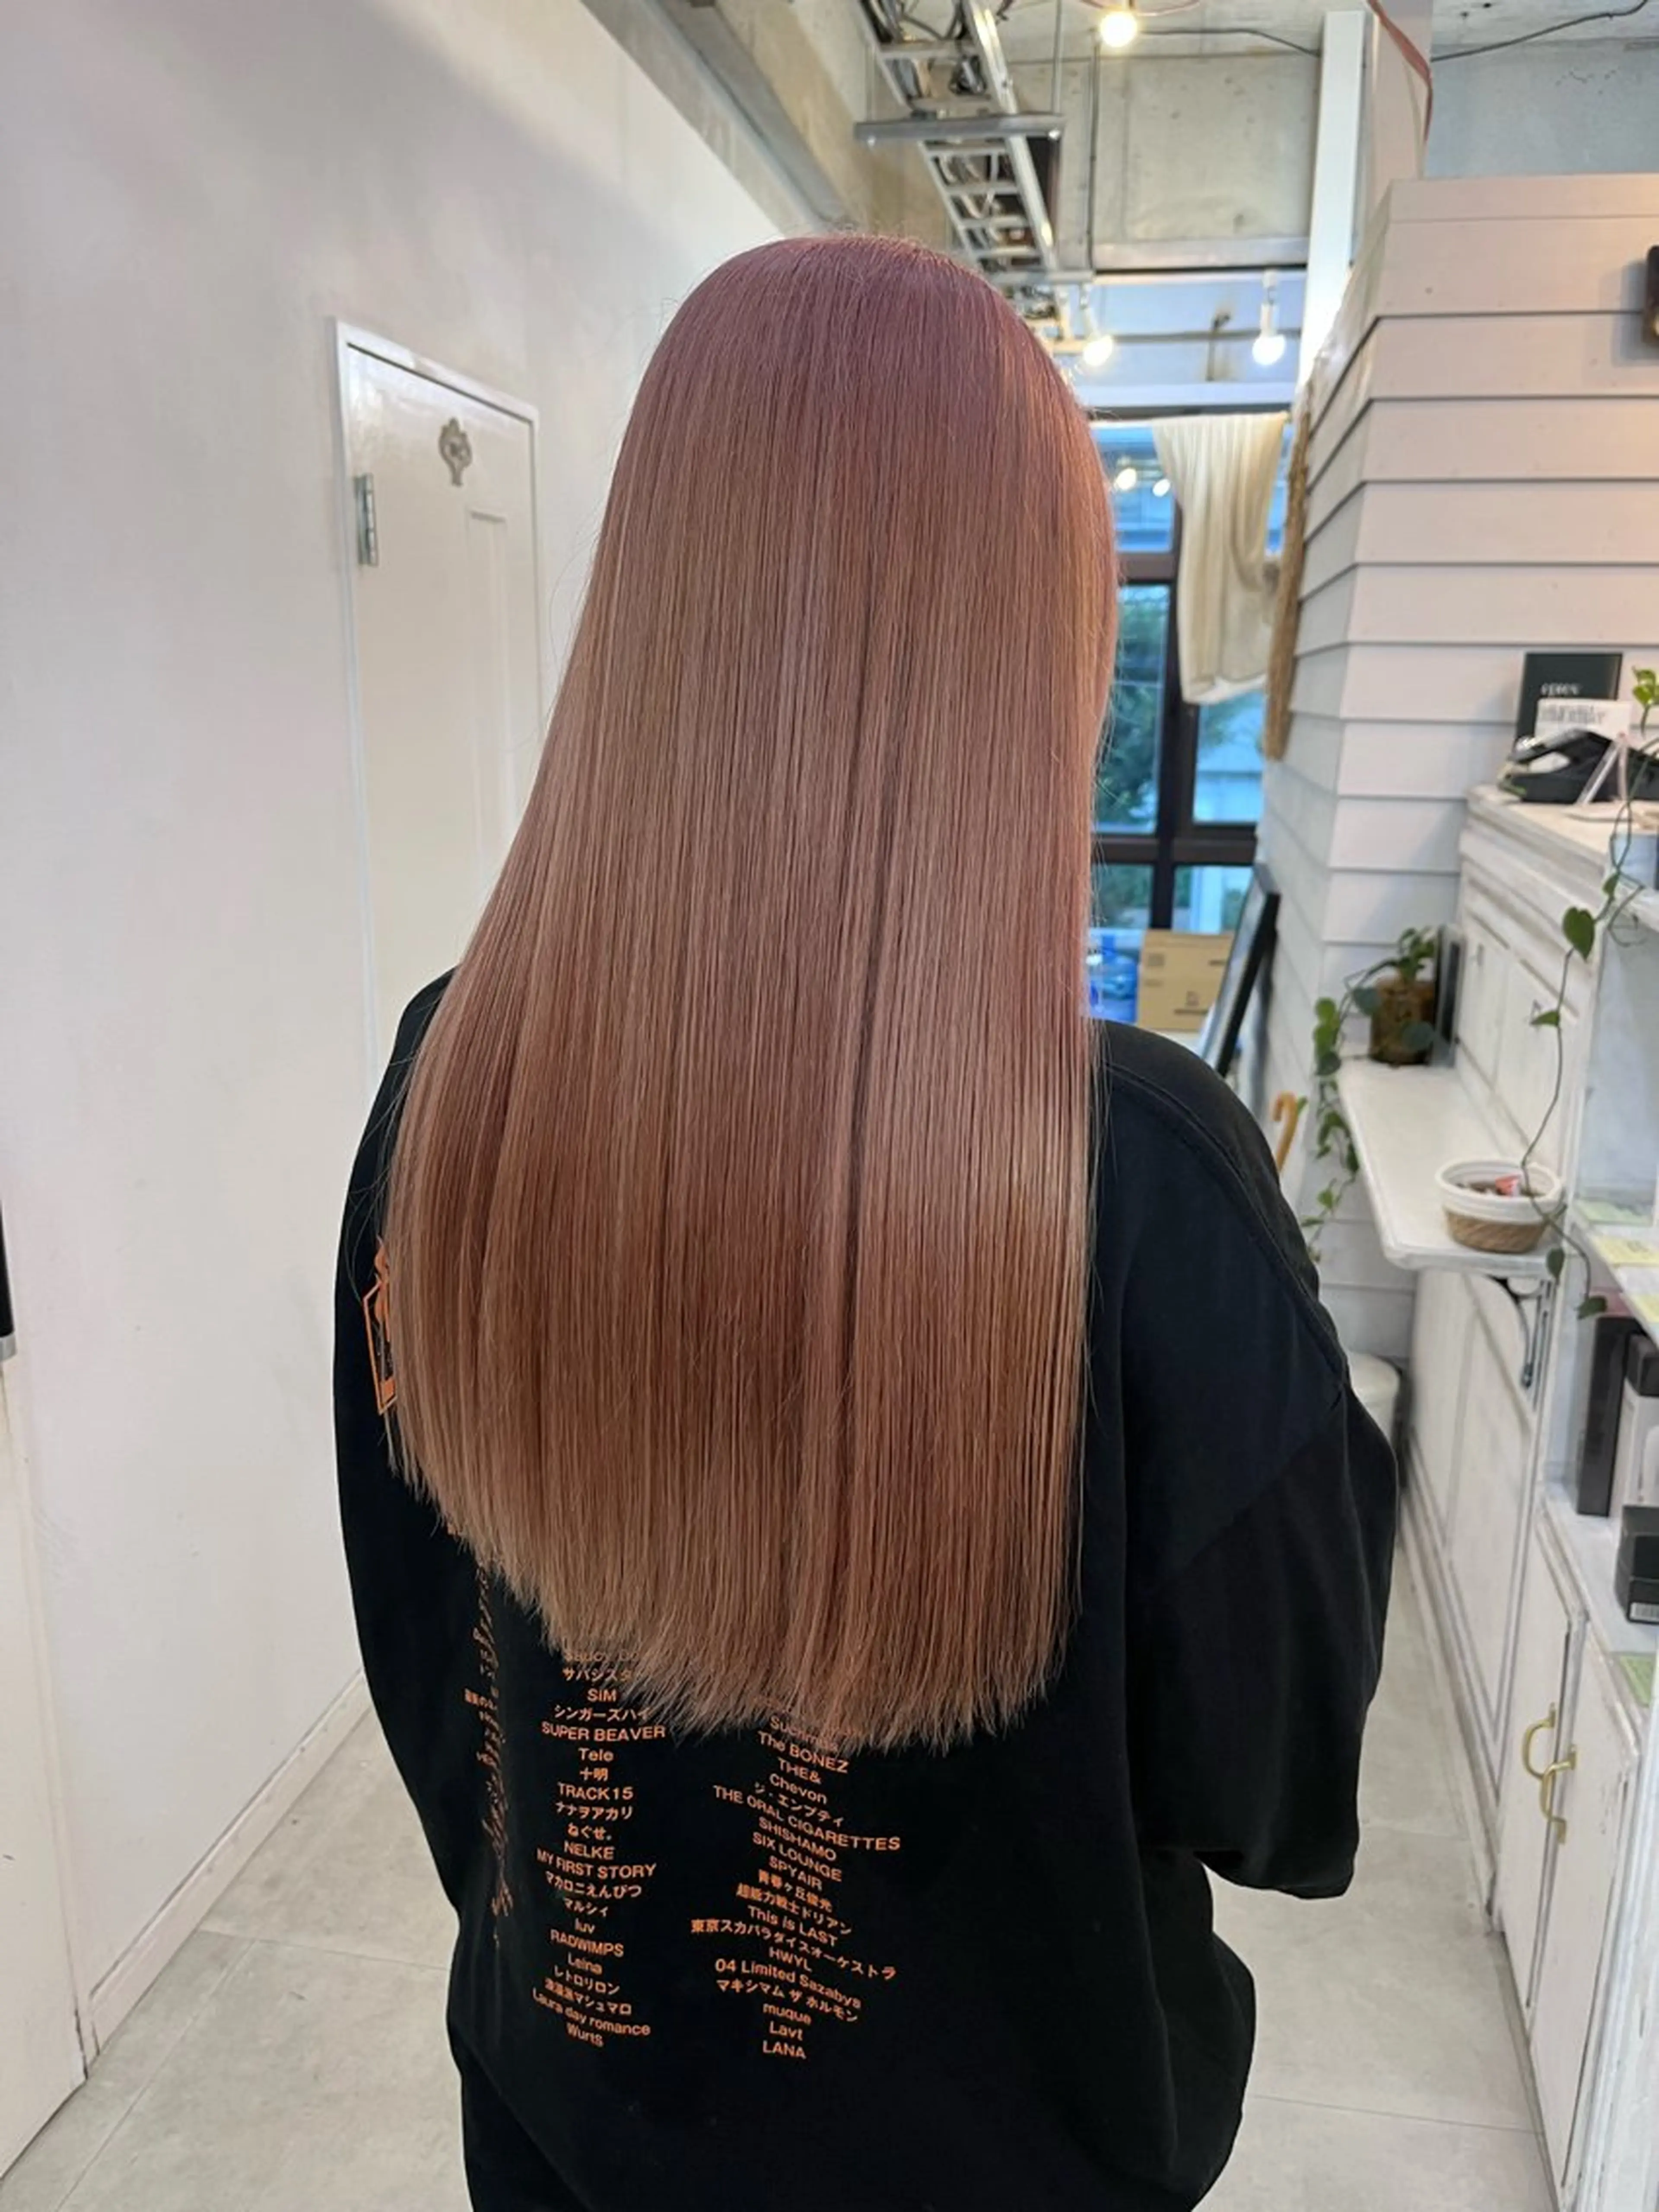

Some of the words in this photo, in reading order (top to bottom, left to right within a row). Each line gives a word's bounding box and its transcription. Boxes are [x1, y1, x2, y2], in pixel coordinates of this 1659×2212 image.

[587, 1688, 617, 1702] SIM
[555, 1704, 649, 1722] シンガーズハイ
[541, 1721, 590, 1740] SUPER
[594, 1725, 666, 1742] BEAVER
[578, 1748, 614, 1762] Tele
[758, 1731, 785, 1751] The
[789, 1744, 849, 1773] BONEZ
[580, 1767, 608, 1781] 十明
[778, 1757, 821, 1784] THE&
[769, 1773, 827, 1805] Chevon
[556, 1801, 633, 1821] ナナヲアカリ
[713, 1785, 744, 1804] THE
[747, 1795, 784, 1821] ORAL
[788, 1815, 901, 1851] CIGARETTES
[564, 1840, 615, 1860] NELKE
[758, 1816, 837, 1861] SHISHAMO
[537, 1847, 554, 1865] MY
[556, 1856, 594, 1877] FIRST
[597, 1862, 657, 1879] STORY
[753, 1831, 776, 1851] SIX
[779, 1844, 842, 1882] LOUNGE
[545, 1870, 642, 1899] マカロニえんぴつ
[769, 1855, 823, 1891] SPYAIR
[575, 1917, 595, 1934] luv
[747, 1904, 779, 1926] This
[782, 1915, 795, 1930] is
[799, 1924, 839, 1947] LAST
[550, 1929, 624, 1958] RADWIMPS
[769, 1946, 813, 1972] HWYL
[554, 1965, 620, 1996] レトロリロン
[715, 1958, 736, 1973] 04
[741, 1960, 796, 1984] Limited
[799, 1974, 862, 2009] Sazabys
[716, 1979, 785, 1999] マキシマム
[806, 1995, 858, 2022] ホルモン
[763, 2003, 813, 2024] muque
[589, 2016, 651, 2036] romance
[769, 2021, 803, 2041] Lavt
[763, 2040, 807, 2059] LANA
